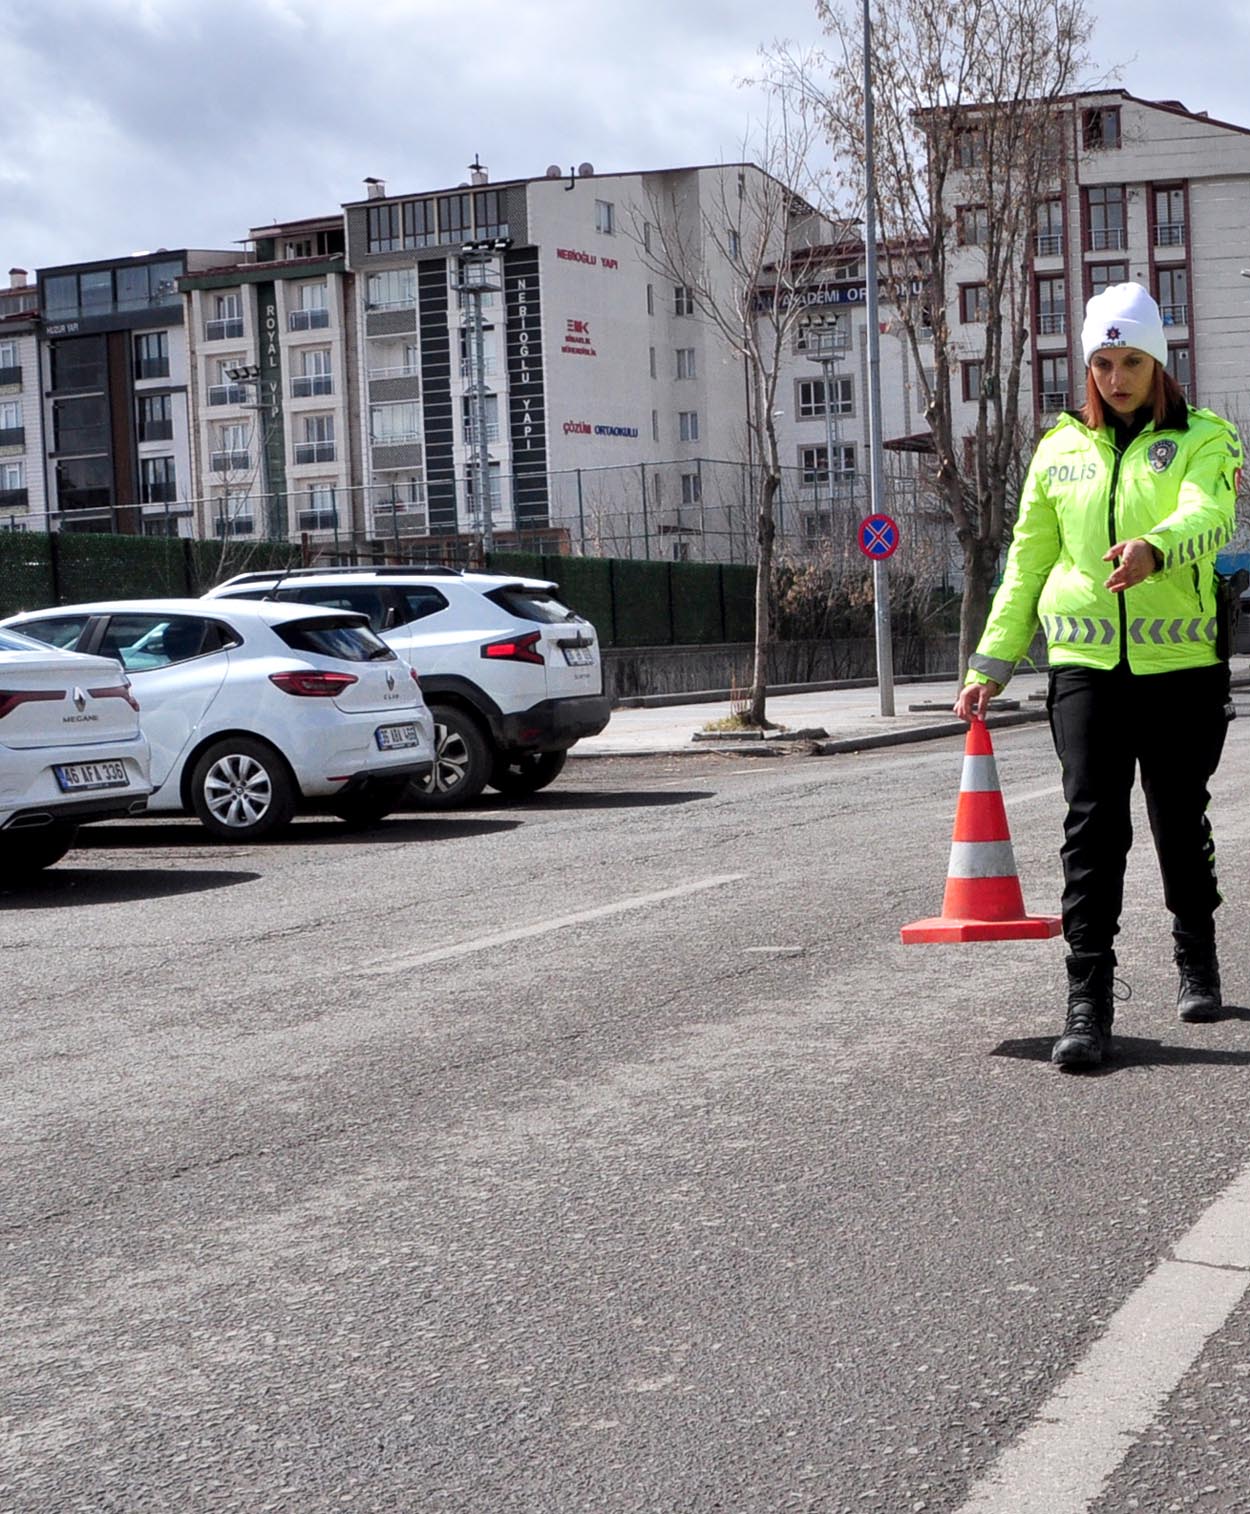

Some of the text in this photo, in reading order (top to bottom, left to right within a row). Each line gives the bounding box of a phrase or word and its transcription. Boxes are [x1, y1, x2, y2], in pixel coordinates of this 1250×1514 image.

[600, 257, 618, 270] YAPI
[266, 305, 279, 418] ROYAL VIP
[523, 399, 533, 450] YAPI
[563, 420, 639, 438] ÇÖZÜM ORTAOKULU
[62, 714, 99, 723] MEGANE
[63, 763, 124, 785] 46 AFA 336
